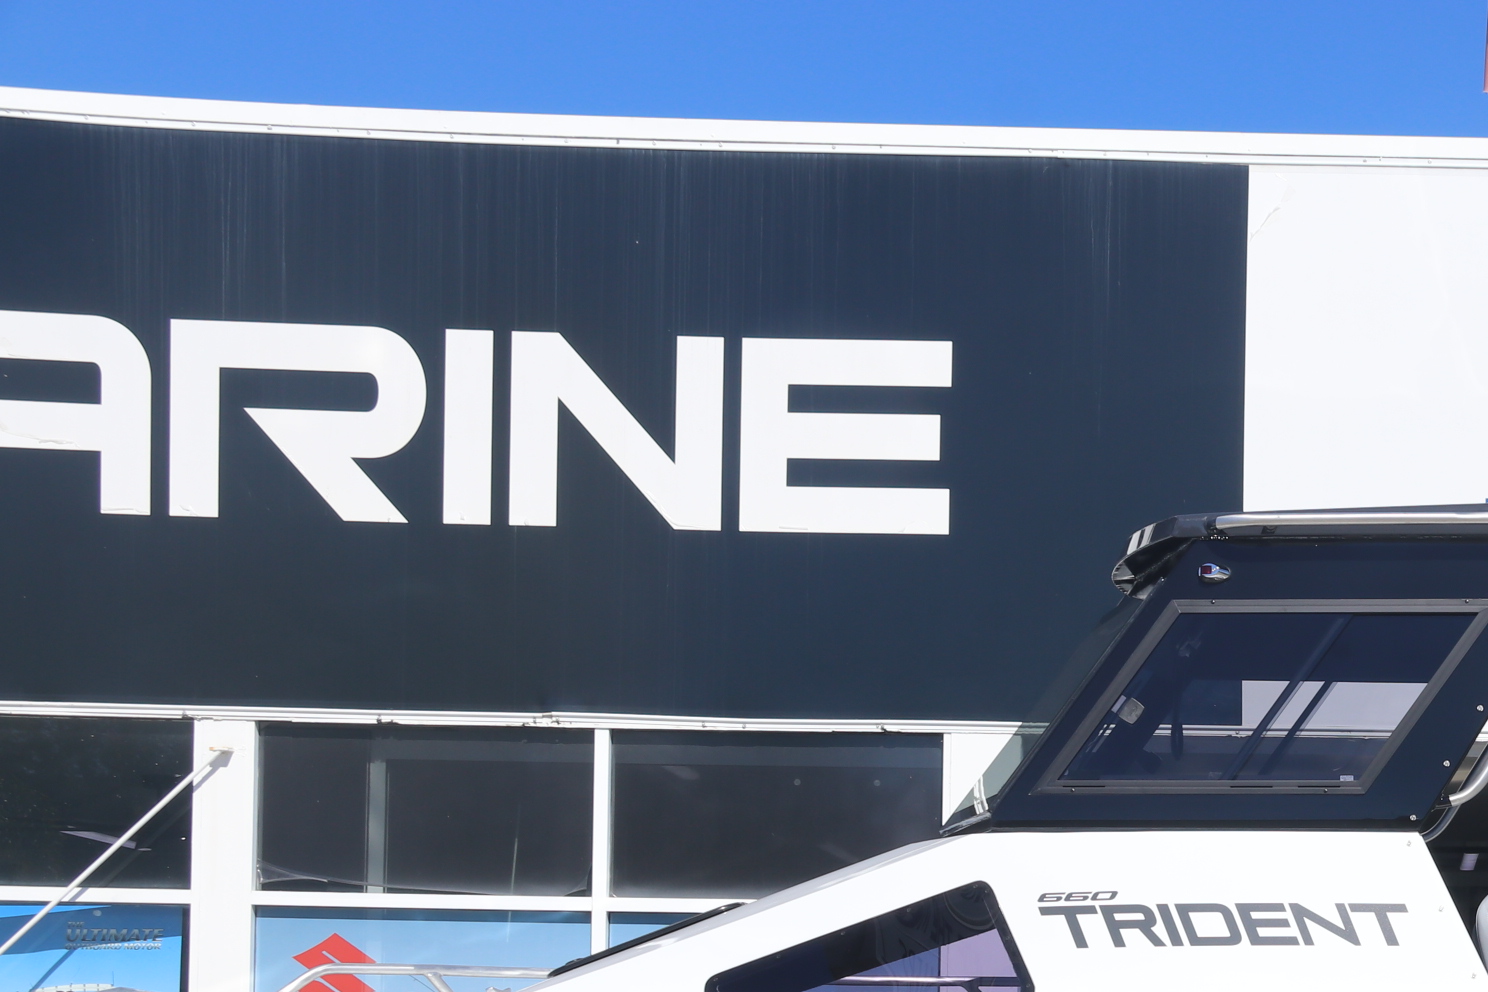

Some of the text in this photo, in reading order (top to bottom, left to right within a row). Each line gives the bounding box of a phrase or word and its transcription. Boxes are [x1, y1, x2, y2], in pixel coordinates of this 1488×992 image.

[1036, 890, 1119, 902] 660
[1038, 902, 1409, 949] TRIDENT
[66, 928, 164, 942] ULTIMATE
